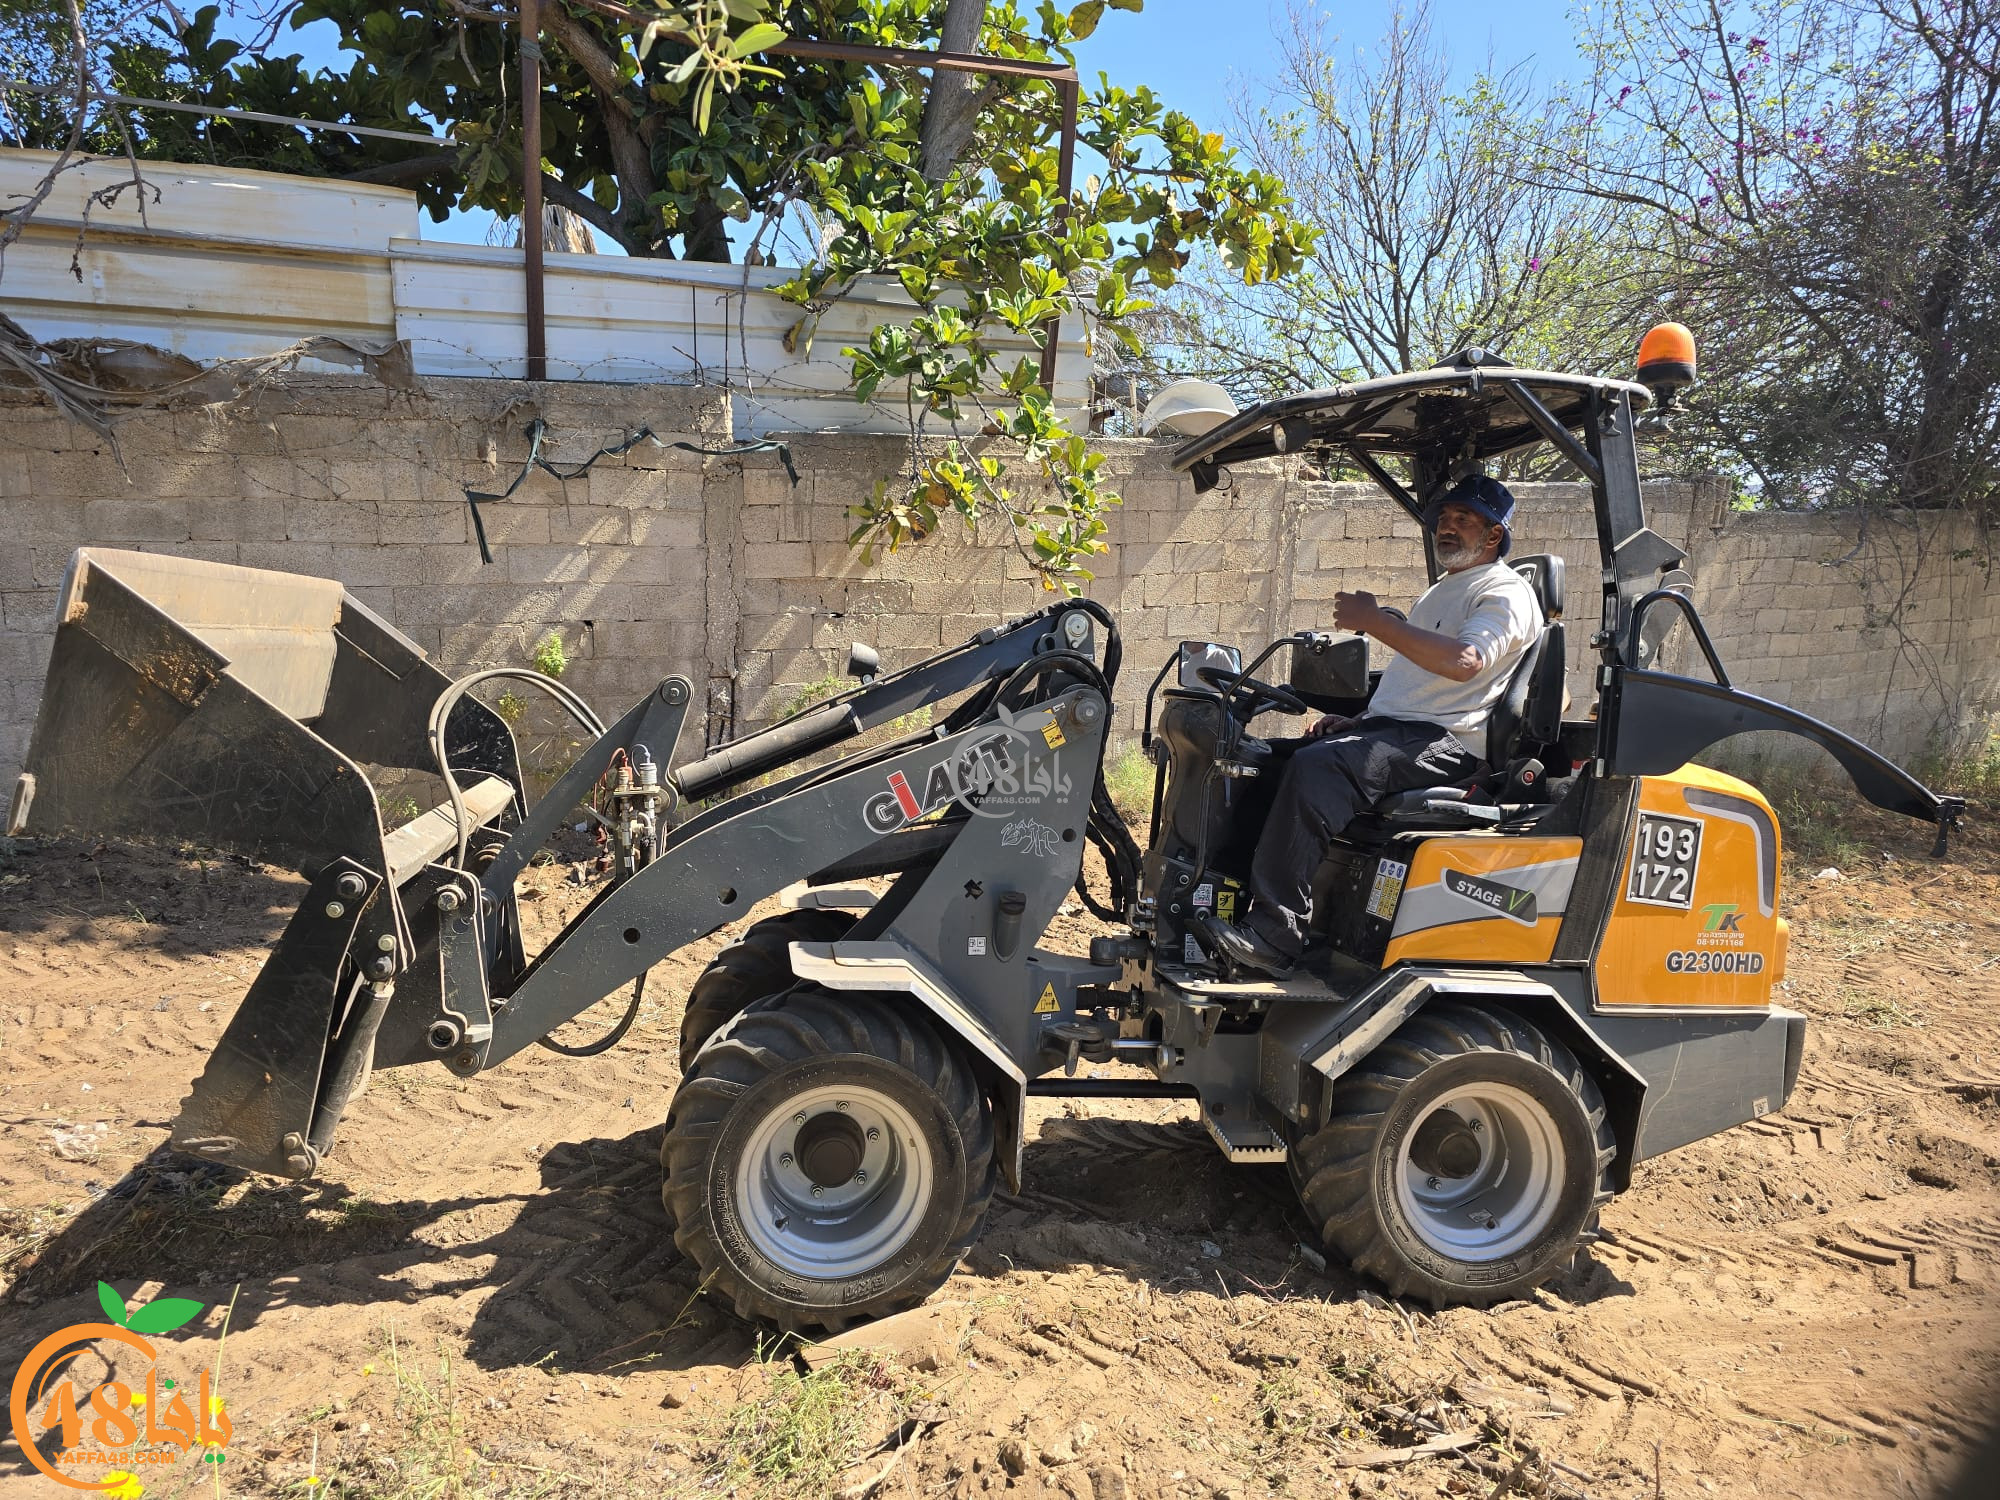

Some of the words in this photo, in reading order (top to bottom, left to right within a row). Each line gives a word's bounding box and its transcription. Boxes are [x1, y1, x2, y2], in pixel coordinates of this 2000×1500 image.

[1641, 823, 1694, 861] 193
[1456, 880, 1502, 907] STAGE
[1637, 863, 1688, 900] 172
[1666, 950, 1764, 974] G2300HD
